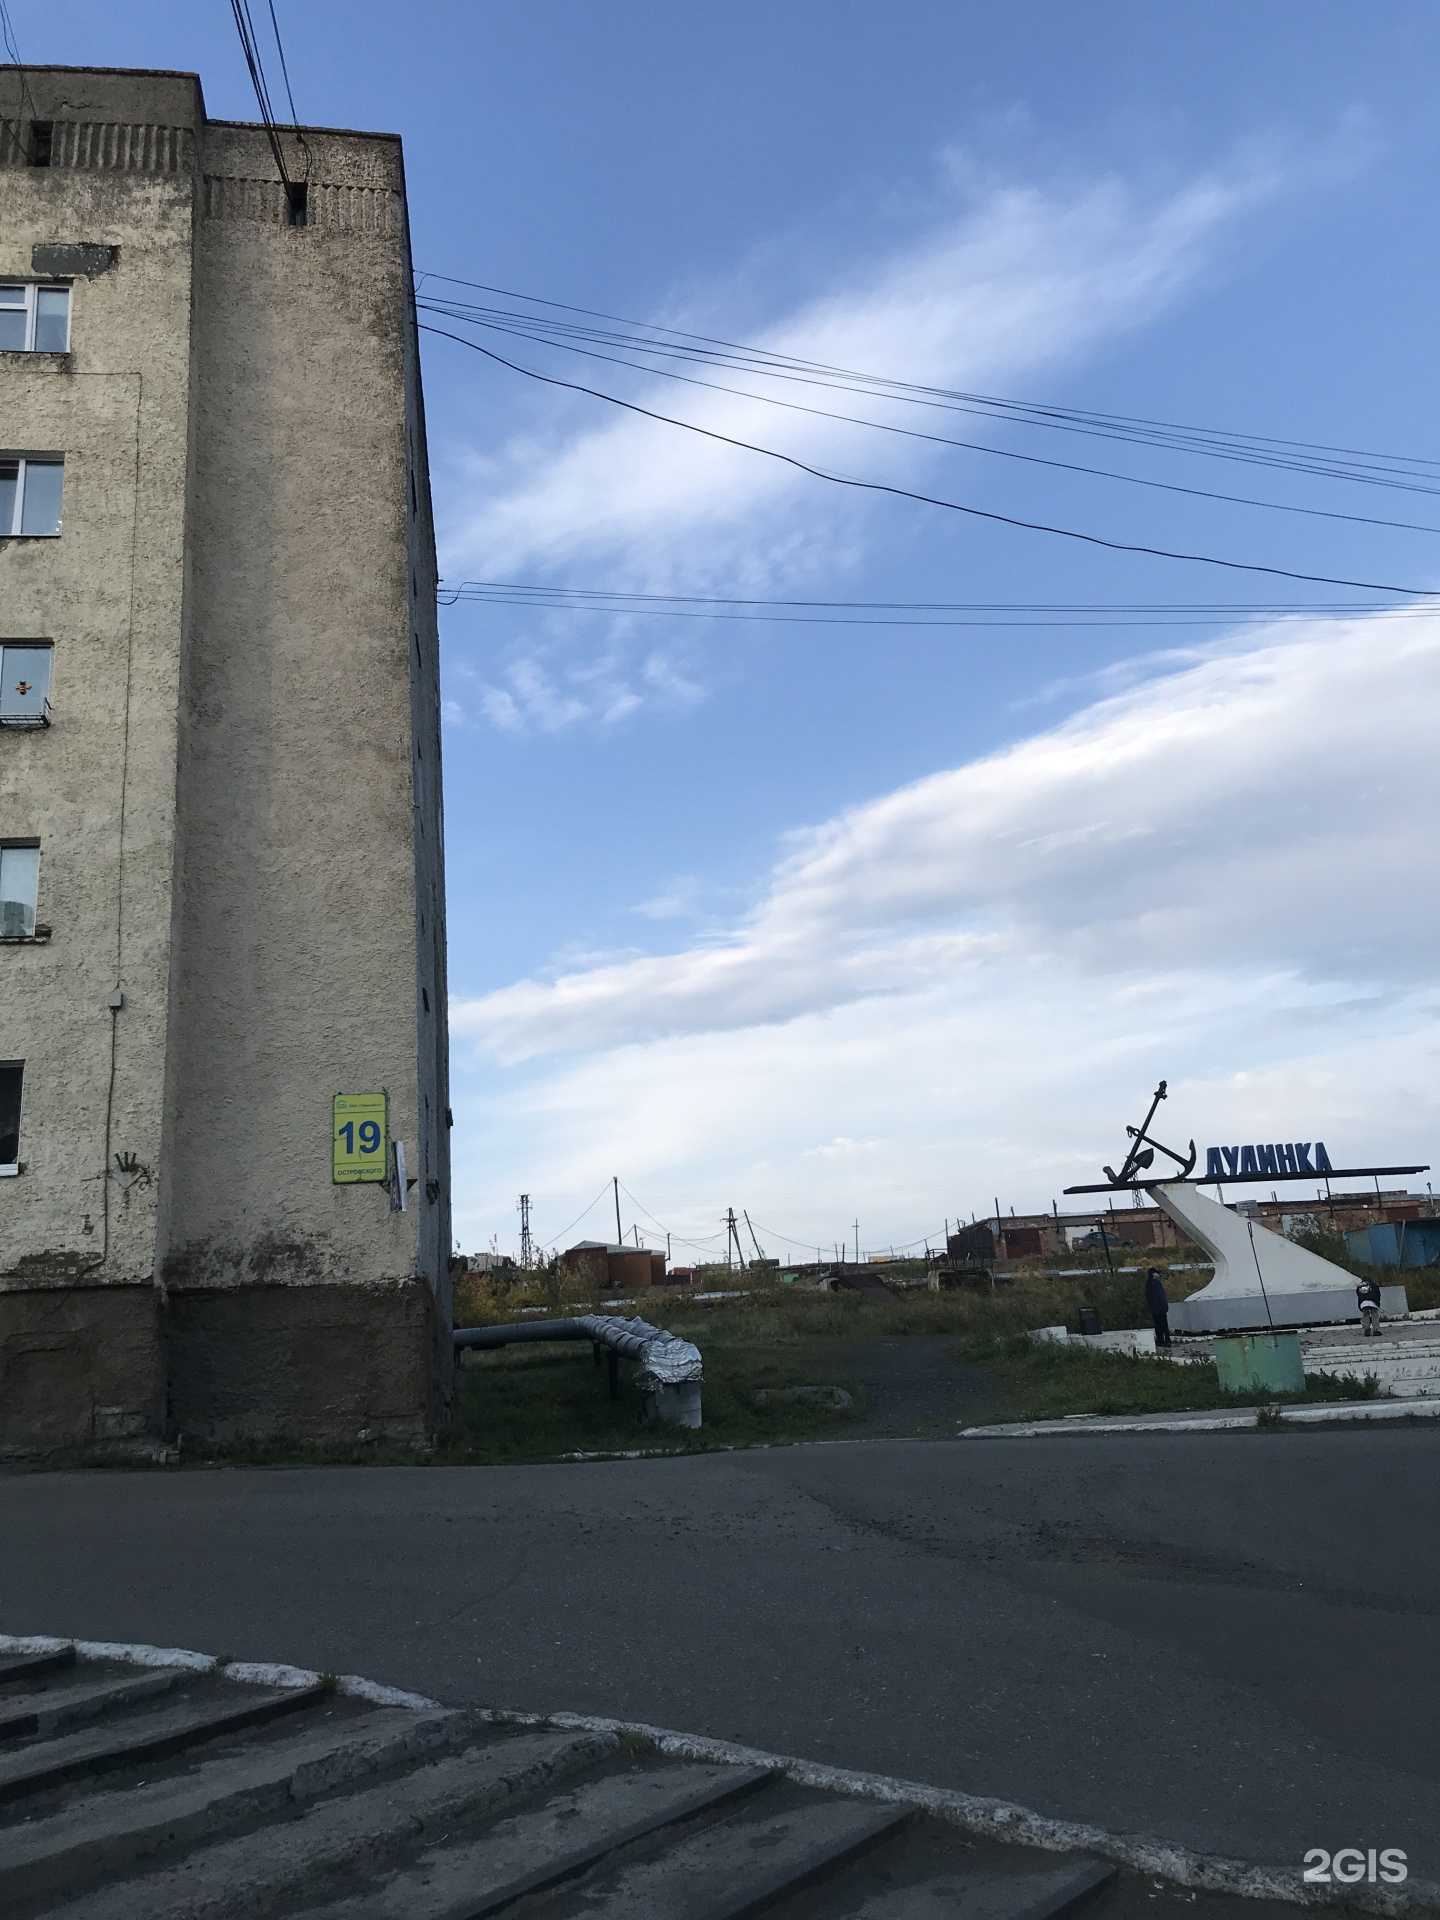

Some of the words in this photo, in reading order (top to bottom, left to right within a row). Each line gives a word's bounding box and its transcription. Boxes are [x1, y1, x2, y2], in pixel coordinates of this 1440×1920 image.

[338, 1120, 381, 1154] 19
[337, 1168, 383, 1176] ОСТРОВСКОГО
[1206, 1142, 1333, 1176] ДУДИНКА
